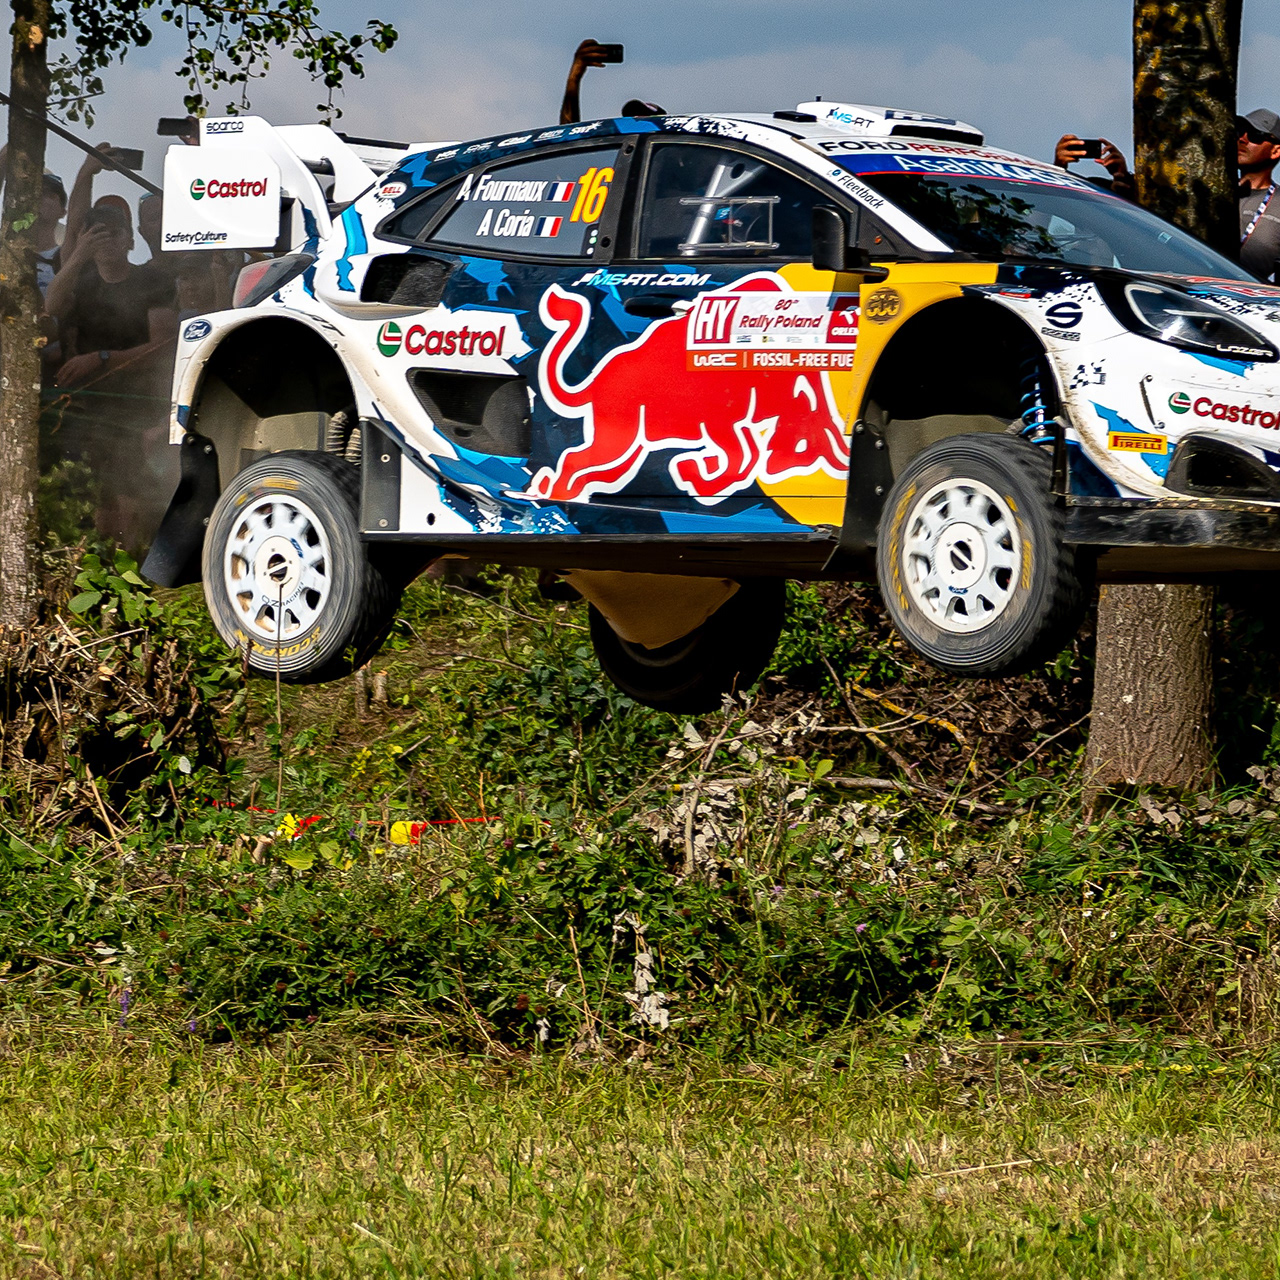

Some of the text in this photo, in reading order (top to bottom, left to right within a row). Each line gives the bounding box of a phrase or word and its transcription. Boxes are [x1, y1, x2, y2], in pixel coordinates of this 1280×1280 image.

[206, 121, 244, 132] sparco
[818, 140, 909, 152] FORD
[207, 178, 268, 198] Castrol
[381, 186, 402, 194] BELL
[456, 173, 549, 202] A Fourmaux
[570, 167, 615, 223] 16
[837, 174, 884, 209] Fleetback
[476, 209, 536, 237] A Coria
[165, 231, 228, 244] SafetyCulture
[588, 270, 712, 286] MS-RT.COM
[694, 298, 739, 342] HY
[739, 315, 824, 332] Rally Poland
[185, 321, 210, 339] Ford
[831, 326, 859, 336] ORLE
[405, 324, 505, 357] Castrol
[694, 353, 854, 367] WRC FOSSIL-FREE FUE
[1112, 435, 1162, 451] PIRELLI
